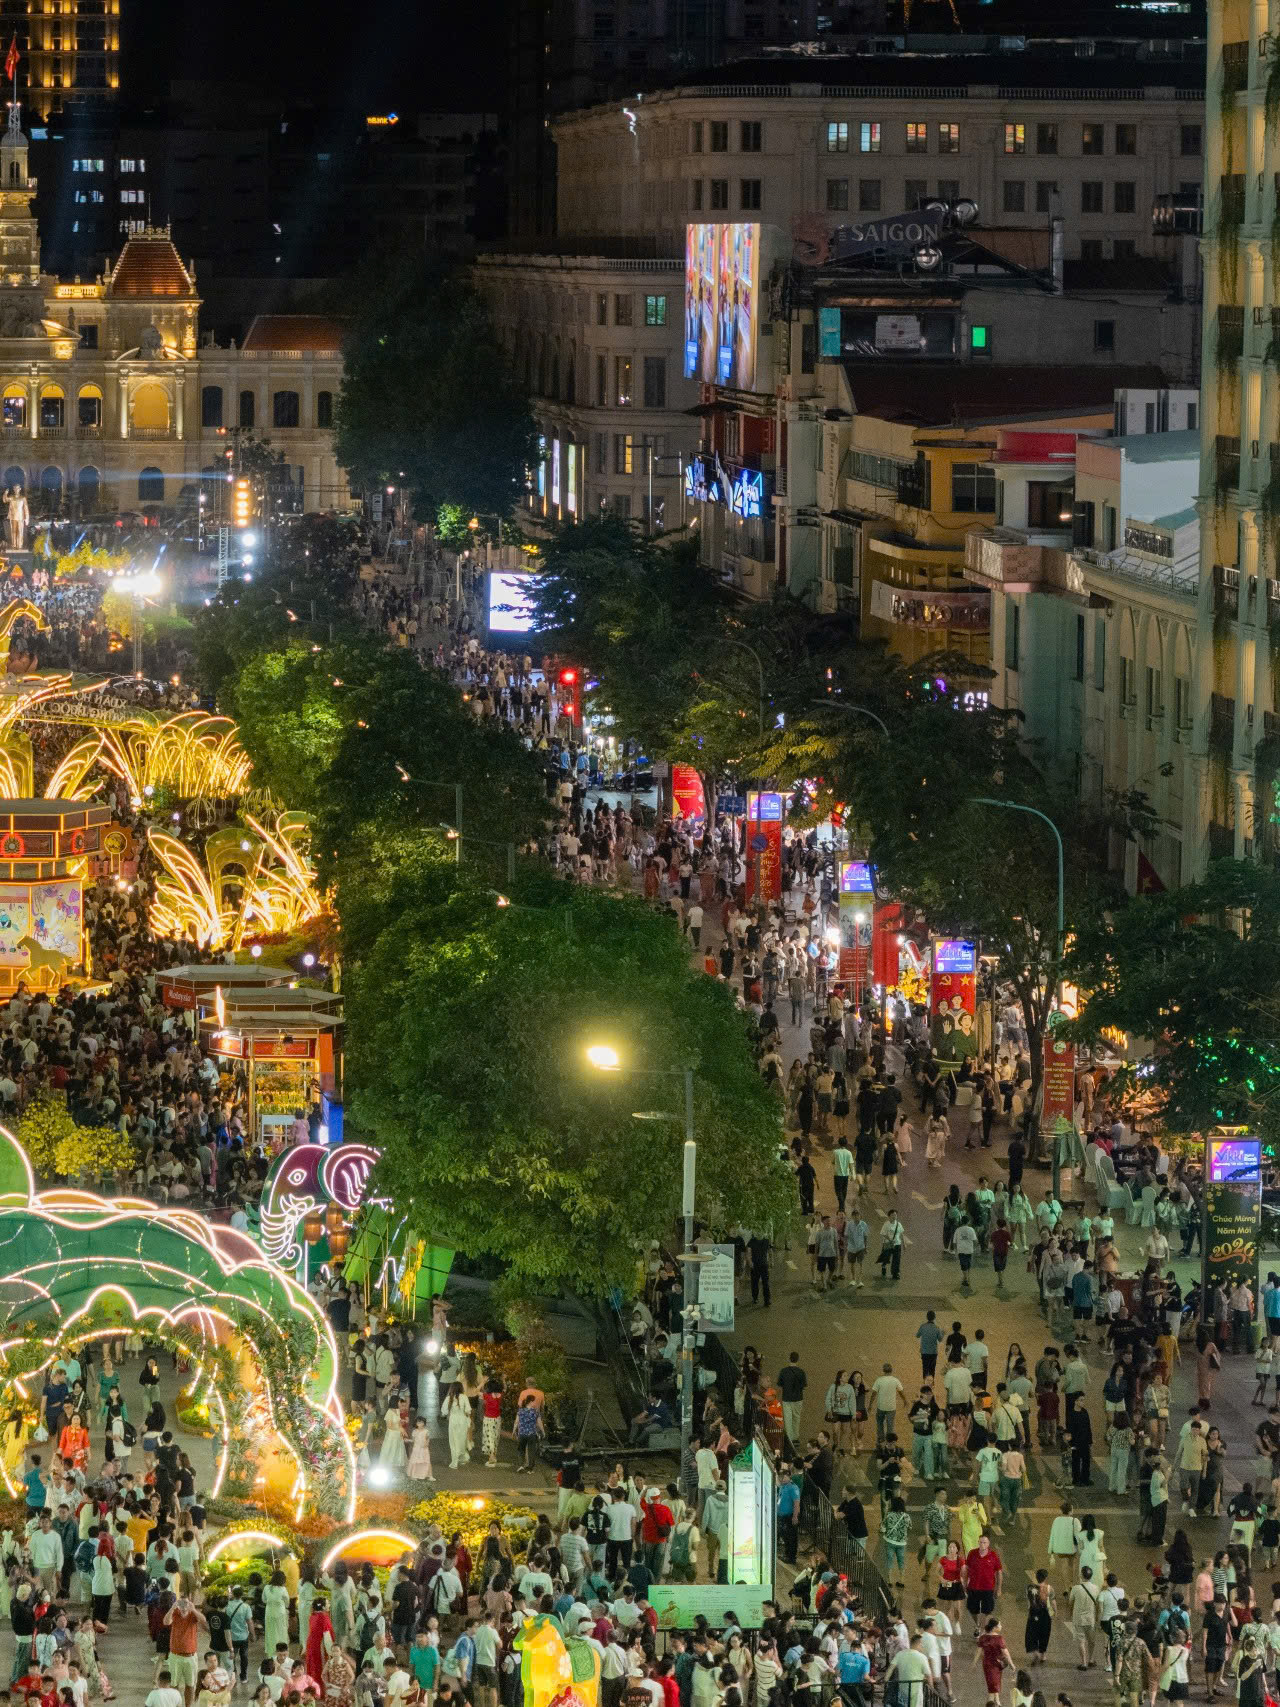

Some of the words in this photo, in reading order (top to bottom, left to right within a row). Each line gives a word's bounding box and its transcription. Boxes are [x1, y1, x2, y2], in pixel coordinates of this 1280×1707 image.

[851, 223, 938, 242] SAIGON
[1212, 1215, 1233, 1223] Chúc
[1217, 1227, 1236, 1235] Năm
[1213, 1238, 1257, 1258] 2026
